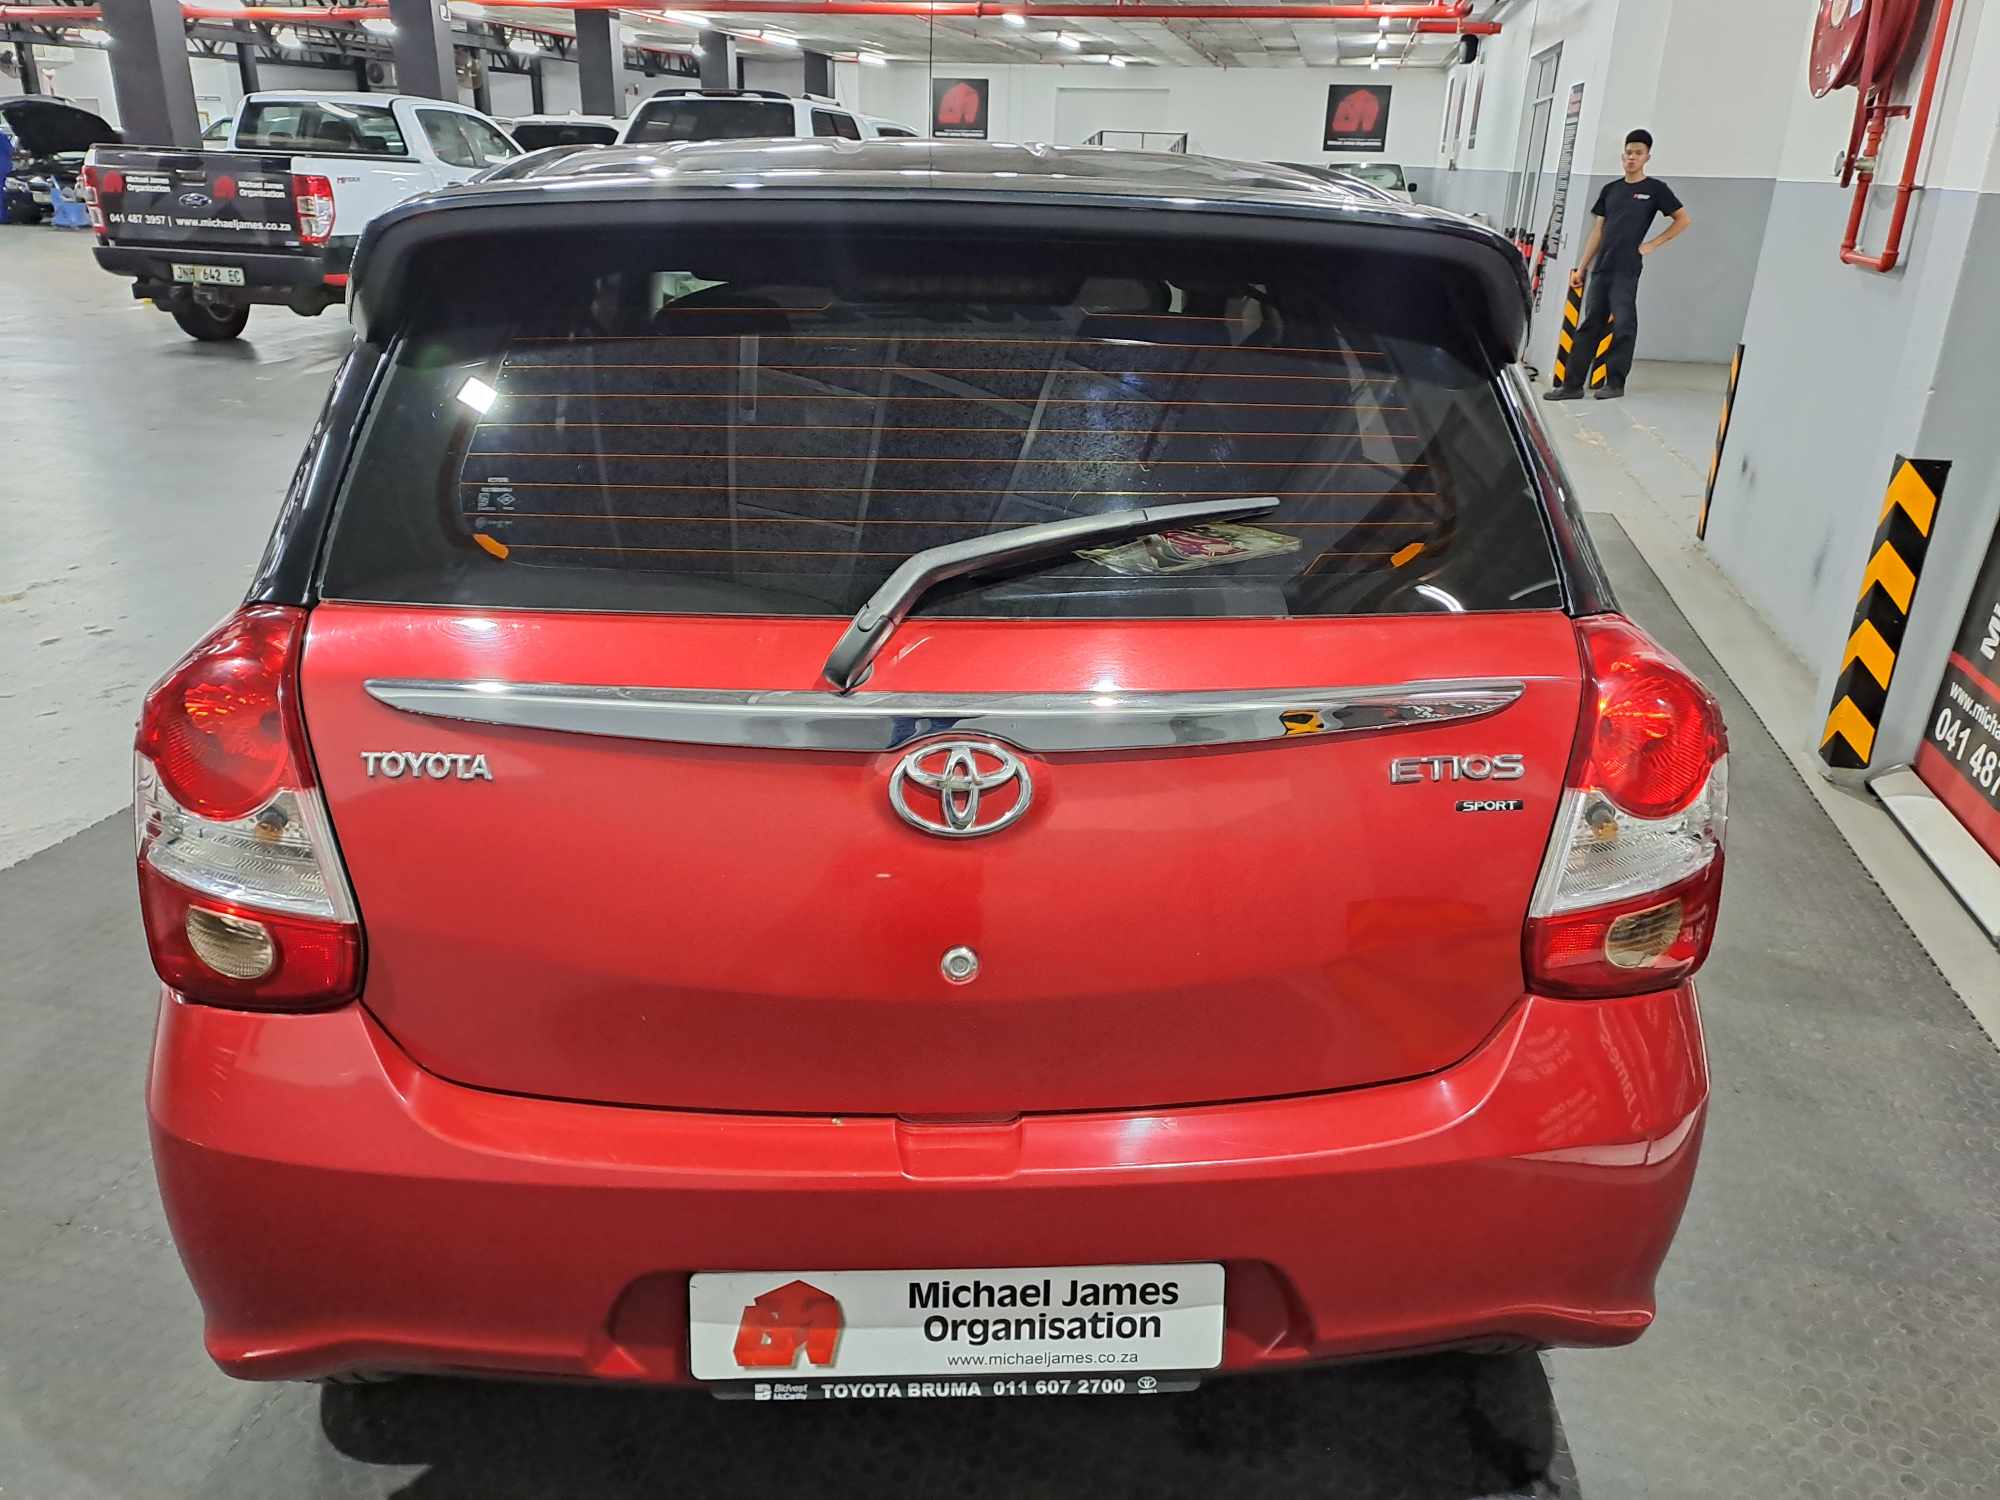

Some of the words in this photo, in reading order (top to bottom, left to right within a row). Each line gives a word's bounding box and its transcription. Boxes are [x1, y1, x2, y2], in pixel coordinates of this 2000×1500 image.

[110, 213, 125, 223] 041
[176, 217, 291, 231] www.michaeljames.co.za
[203, 267, 222, 281] 642
[228, 269, 241, 283] EC
[1935, 707, 1971, 760] 041
[360, 750, 493, 780] TOYOTA
[1389, 754, 1525, 784] ETIOS
[1462, 800, 1518, 812] SPORT
[908, 1279, 1050, 1309] Michael
[1062, 1279, 1179, 1307] James
[923, 1311, 1161, 1346] Organisation
[947, 1351, 1138, 1368] www.michaeljames.co.za
[821, 1382, 902, 1398] TOYOTA
[908, 1382, 982, 1397] BRUMA
[993, 1380, 1027, 1395] 011
[1035, 1380, 1072, 1394] 607
[1077, 1378, 1125, 1394] 2700
